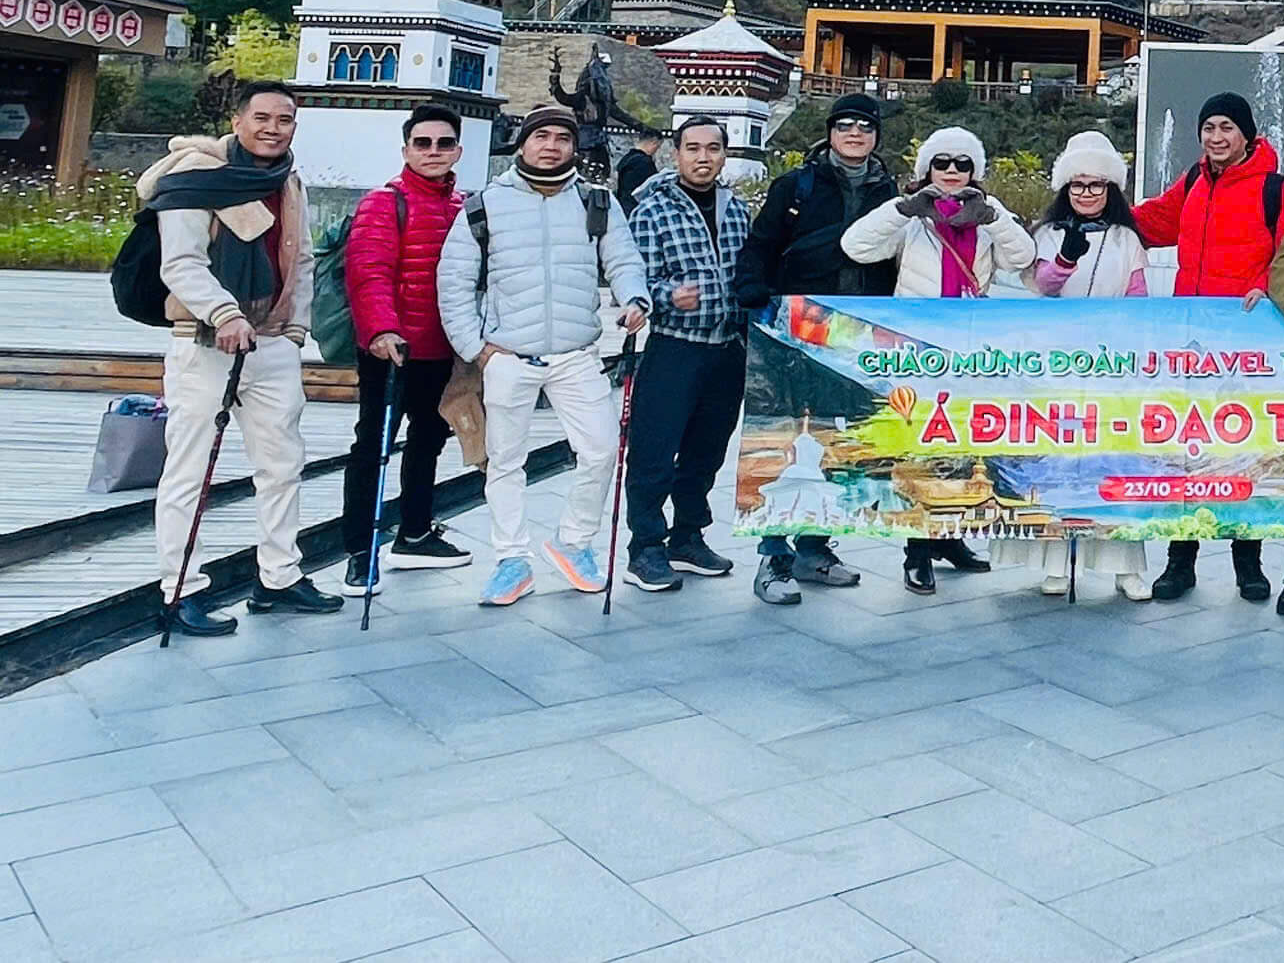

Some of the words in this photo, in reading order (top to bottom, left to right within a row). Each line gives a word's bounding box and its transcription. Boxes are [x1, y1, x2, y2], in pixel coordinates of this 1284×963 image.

[857, 343, 946, 375] CHÀO
[951, 343, 1042, 375] MỪNG
[1048, 344, 1137, 375] ĐOÀN
[1142, 351, 1158, 375] J
[1164, 350, 1274, 374] TRAVEL
[921, 392, 957, 444] Á
[970, 403, 1098, 444] ĐINH
[1141, 403, 1253, 456] ĐẠO
[1124, 482, 1171, 497] 23/10
[1184, 482, 1233, 497] 30/10
